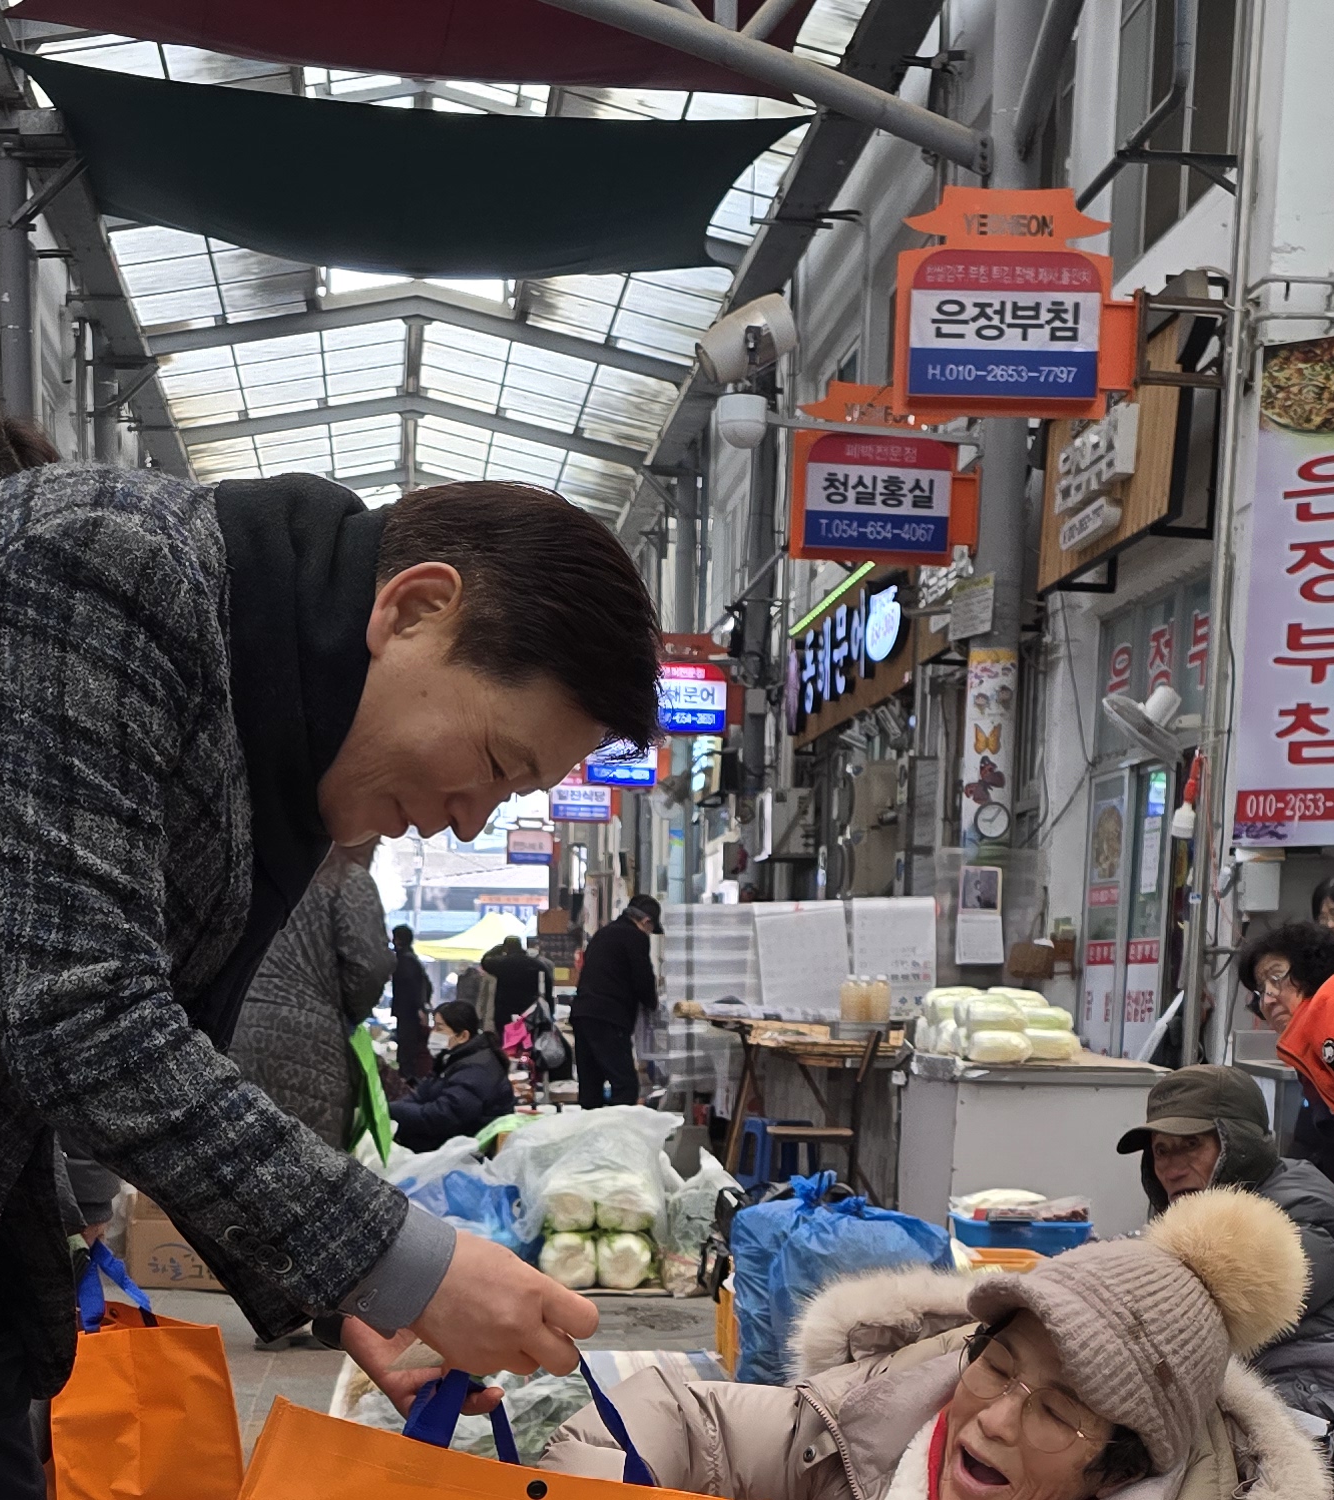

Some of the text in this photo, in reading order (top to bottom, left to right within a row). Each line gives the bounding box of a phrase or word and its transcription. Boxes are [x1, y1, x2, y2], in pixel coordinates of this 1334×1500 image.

[930, 298, 1082, 343] 은정부침
[926, 363, 1079, 384] H.010-2653-7797
[821, 471, 936, 510] 청실홍실
[817, 518, 936, 543] T.054-654-4067
